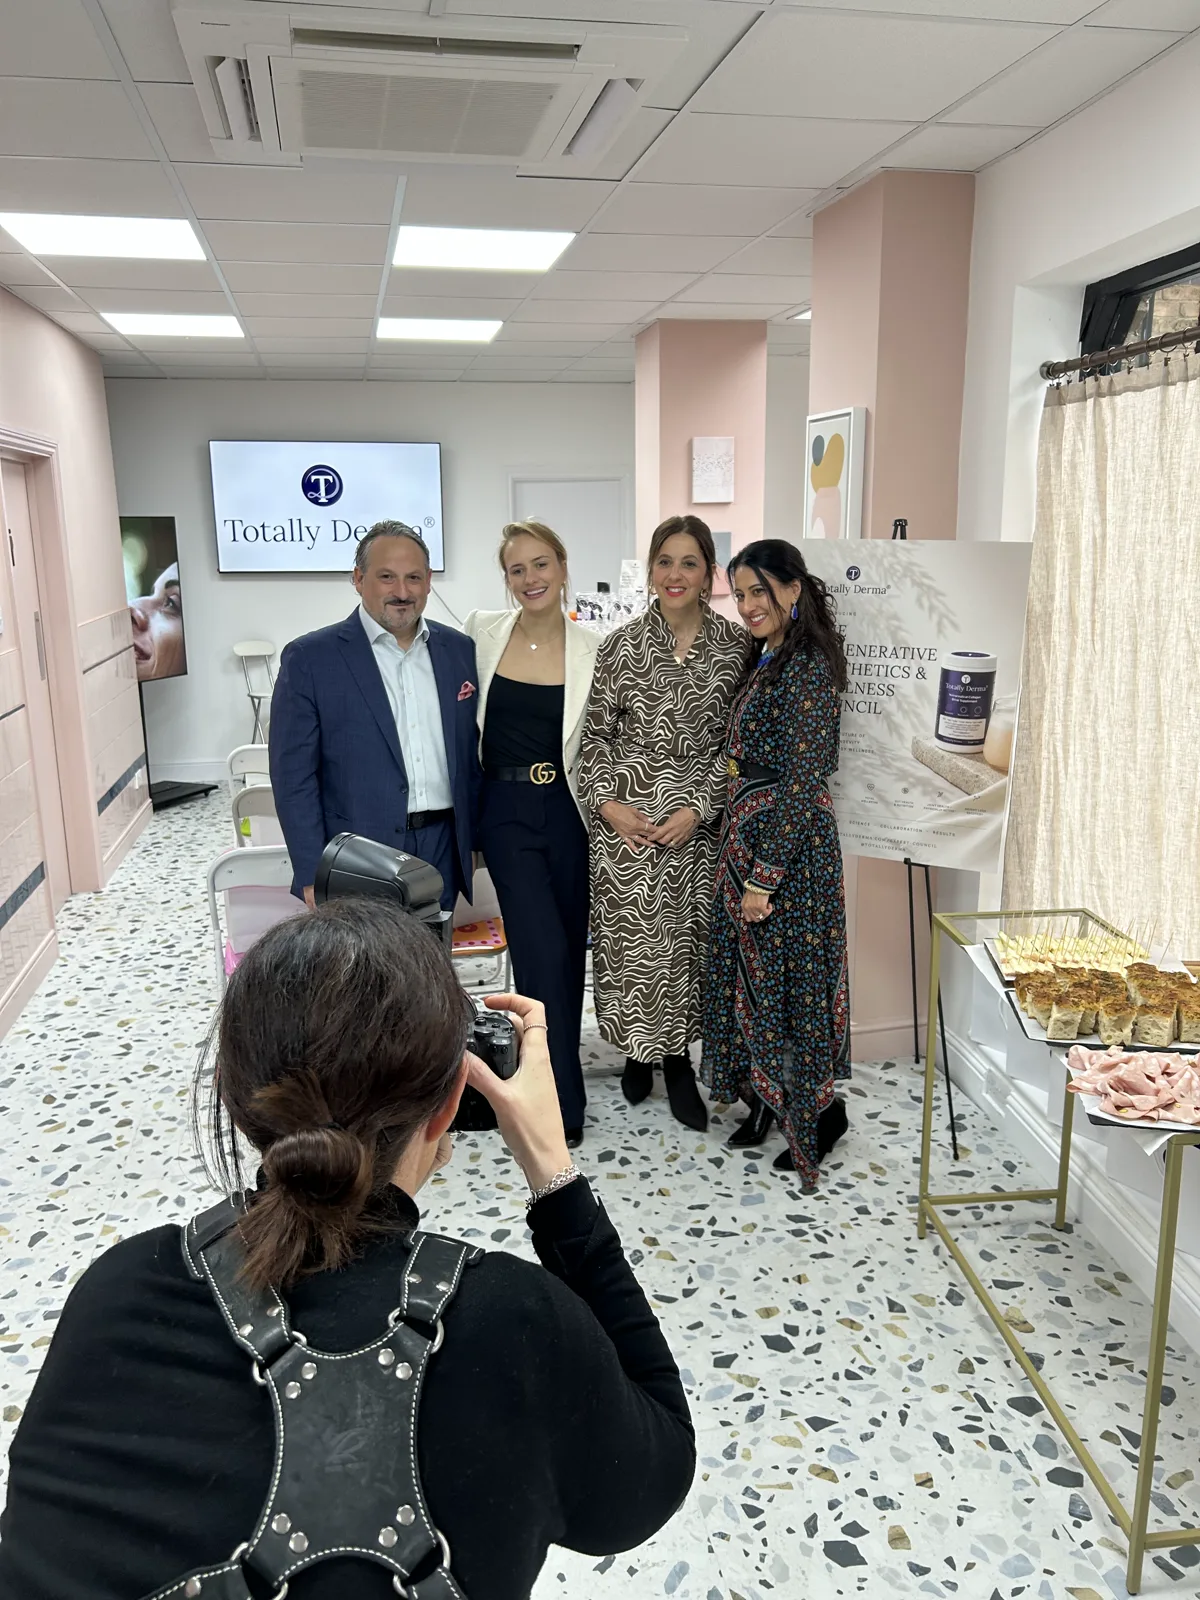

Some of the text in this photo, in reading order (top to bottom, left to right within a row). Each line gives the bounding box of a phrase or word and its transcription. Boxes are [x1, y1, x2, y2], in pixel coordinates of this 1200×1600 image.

[223, 518, 321, 551] Totally
[825, 583, 851, 596] otally
[845, 643, 938, 662] ENERATIVE
[915, 666, 927, 680] &
[845, 681, 895, 697] LNESS
[945, 682, 965, 692] Totally
[840, 699, 882, 715] NCIL
[880, 824, 923, 833] COLLABORATION
